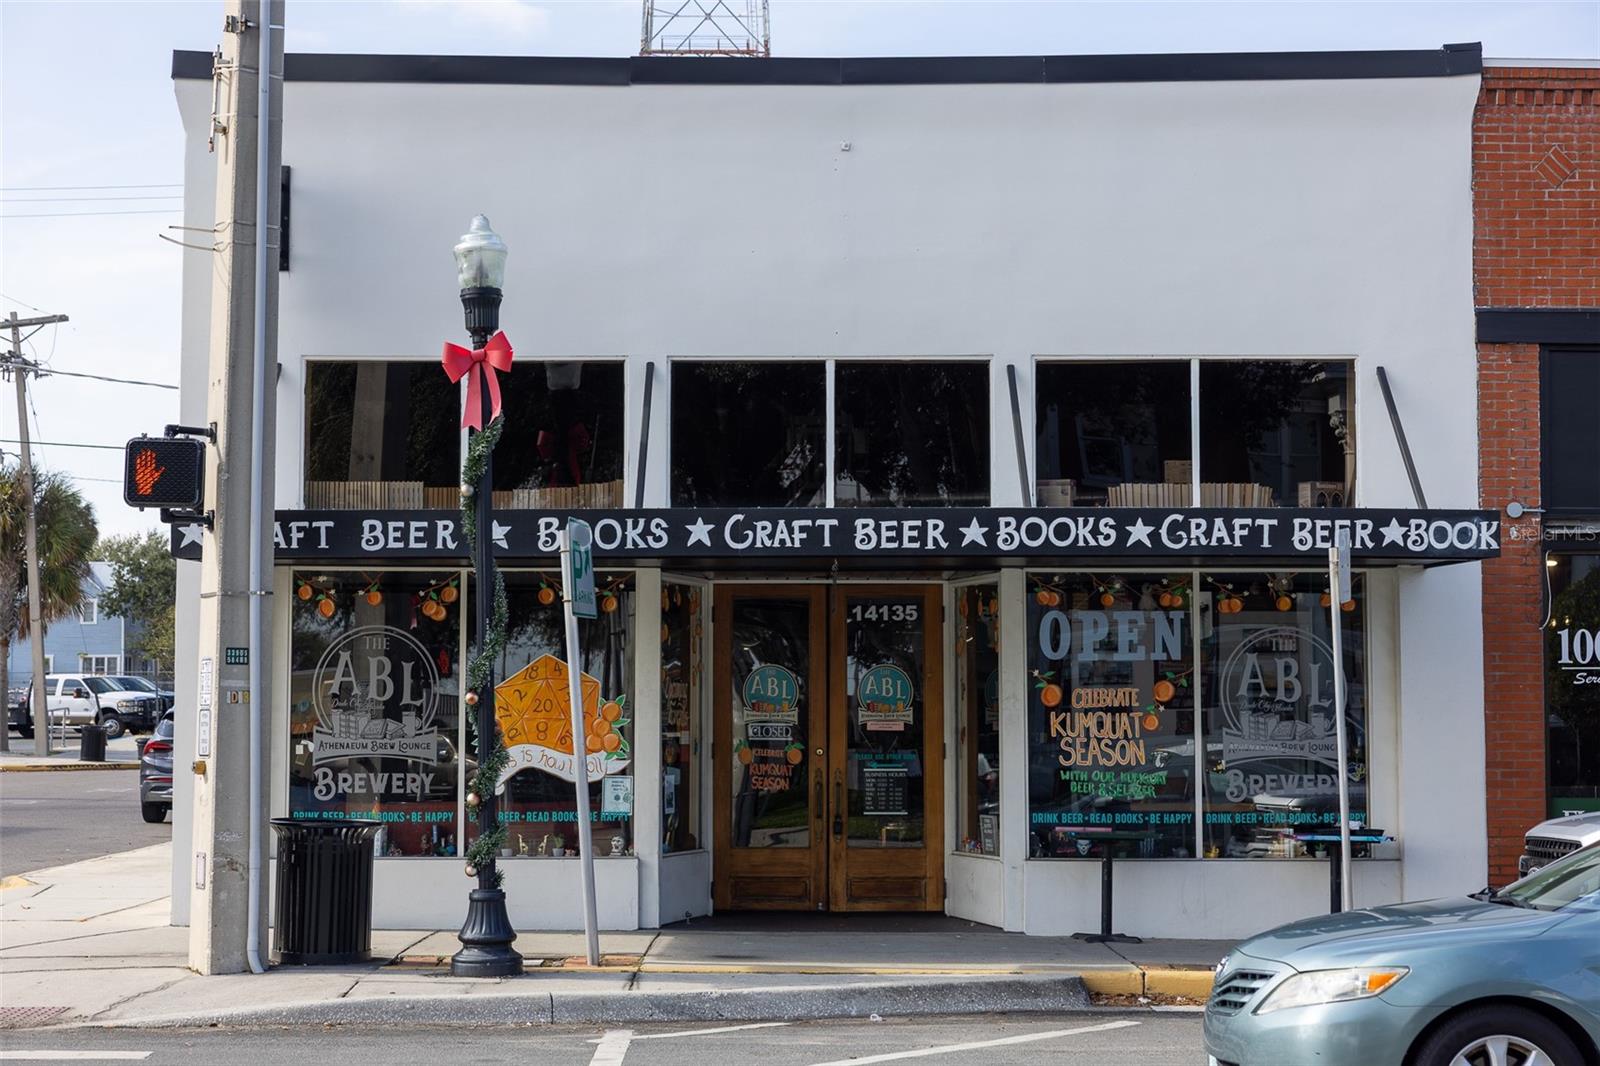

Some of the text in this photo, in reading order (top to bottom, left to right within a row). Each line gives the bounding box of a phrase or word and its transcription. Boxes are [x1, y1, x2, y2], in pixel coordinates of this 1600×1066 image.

[274, 518, 459, 551] AFT BEER
[537, 516, 669, 552] BOKS
[724, 513, 949, 550] CRAFT BEER
[996, 516, 1117, 551] BOOKS
[1158, 513, 1278, 550] CRAFT
[1406, 517, 1500, 551] BOOK
[852, 604, 918, 621] 14135
[364, 637, 390, 650] THE
[1039, 610, 1185, 661] OPEN
[1271, 638, 1297, 652] THE
[329, 650, 424, 707] ABL
[523, 665, 539, 680] 18
[553, 662, 563, 677] 4
[1236, 652, 1333, 708] ABL
[512, 688, 528, 702] 2
[751, 675, 791, 699] ABL
[865, 676, 906, 699] ABL
[1071, 687, 1140, 709] CELEBRATE
[533, 699, 553, 713] 20
[536, 720, 549, 742] 8
[751, 726, 792, 737] CLOSED
[1050, 711, 1144, 739] KUMQUAT
[318, 740, 431, 753] ATHENAEUM BREW LOUNGE
[1058, 737, 1147, 767] SEASON
[1308, 742, 1335, 755] LOUNG
[521, 746, 533, 763] is
[587, 756, 604, 774] oll
[313, 767, 435, 801] BREWERY
[1060, 770, 1088, 781] WITH
[1092, 770, 1116, 783] OUR
[1070, 782, 1095, 795] BEER
[411, 811, 423, 823] BE
[425, 811, 454, 823] HAPPY
[498, 811, 521, 823] BEER
[526, 811, 549, 823] READ
[552, 811, 579, 822] BOOKS
[1032, 812, 1192, 824] DRINK BEER READ BOOKS BE HAPPY
[1206, 812, 1232, 824] DRINK
[1235, 812, 1257, 824] BEER
[1264, 812, 1290, 824] READ
[1290, 812, 1317, 825] BOOKS
[1323, 812, 1335, 824] BE
